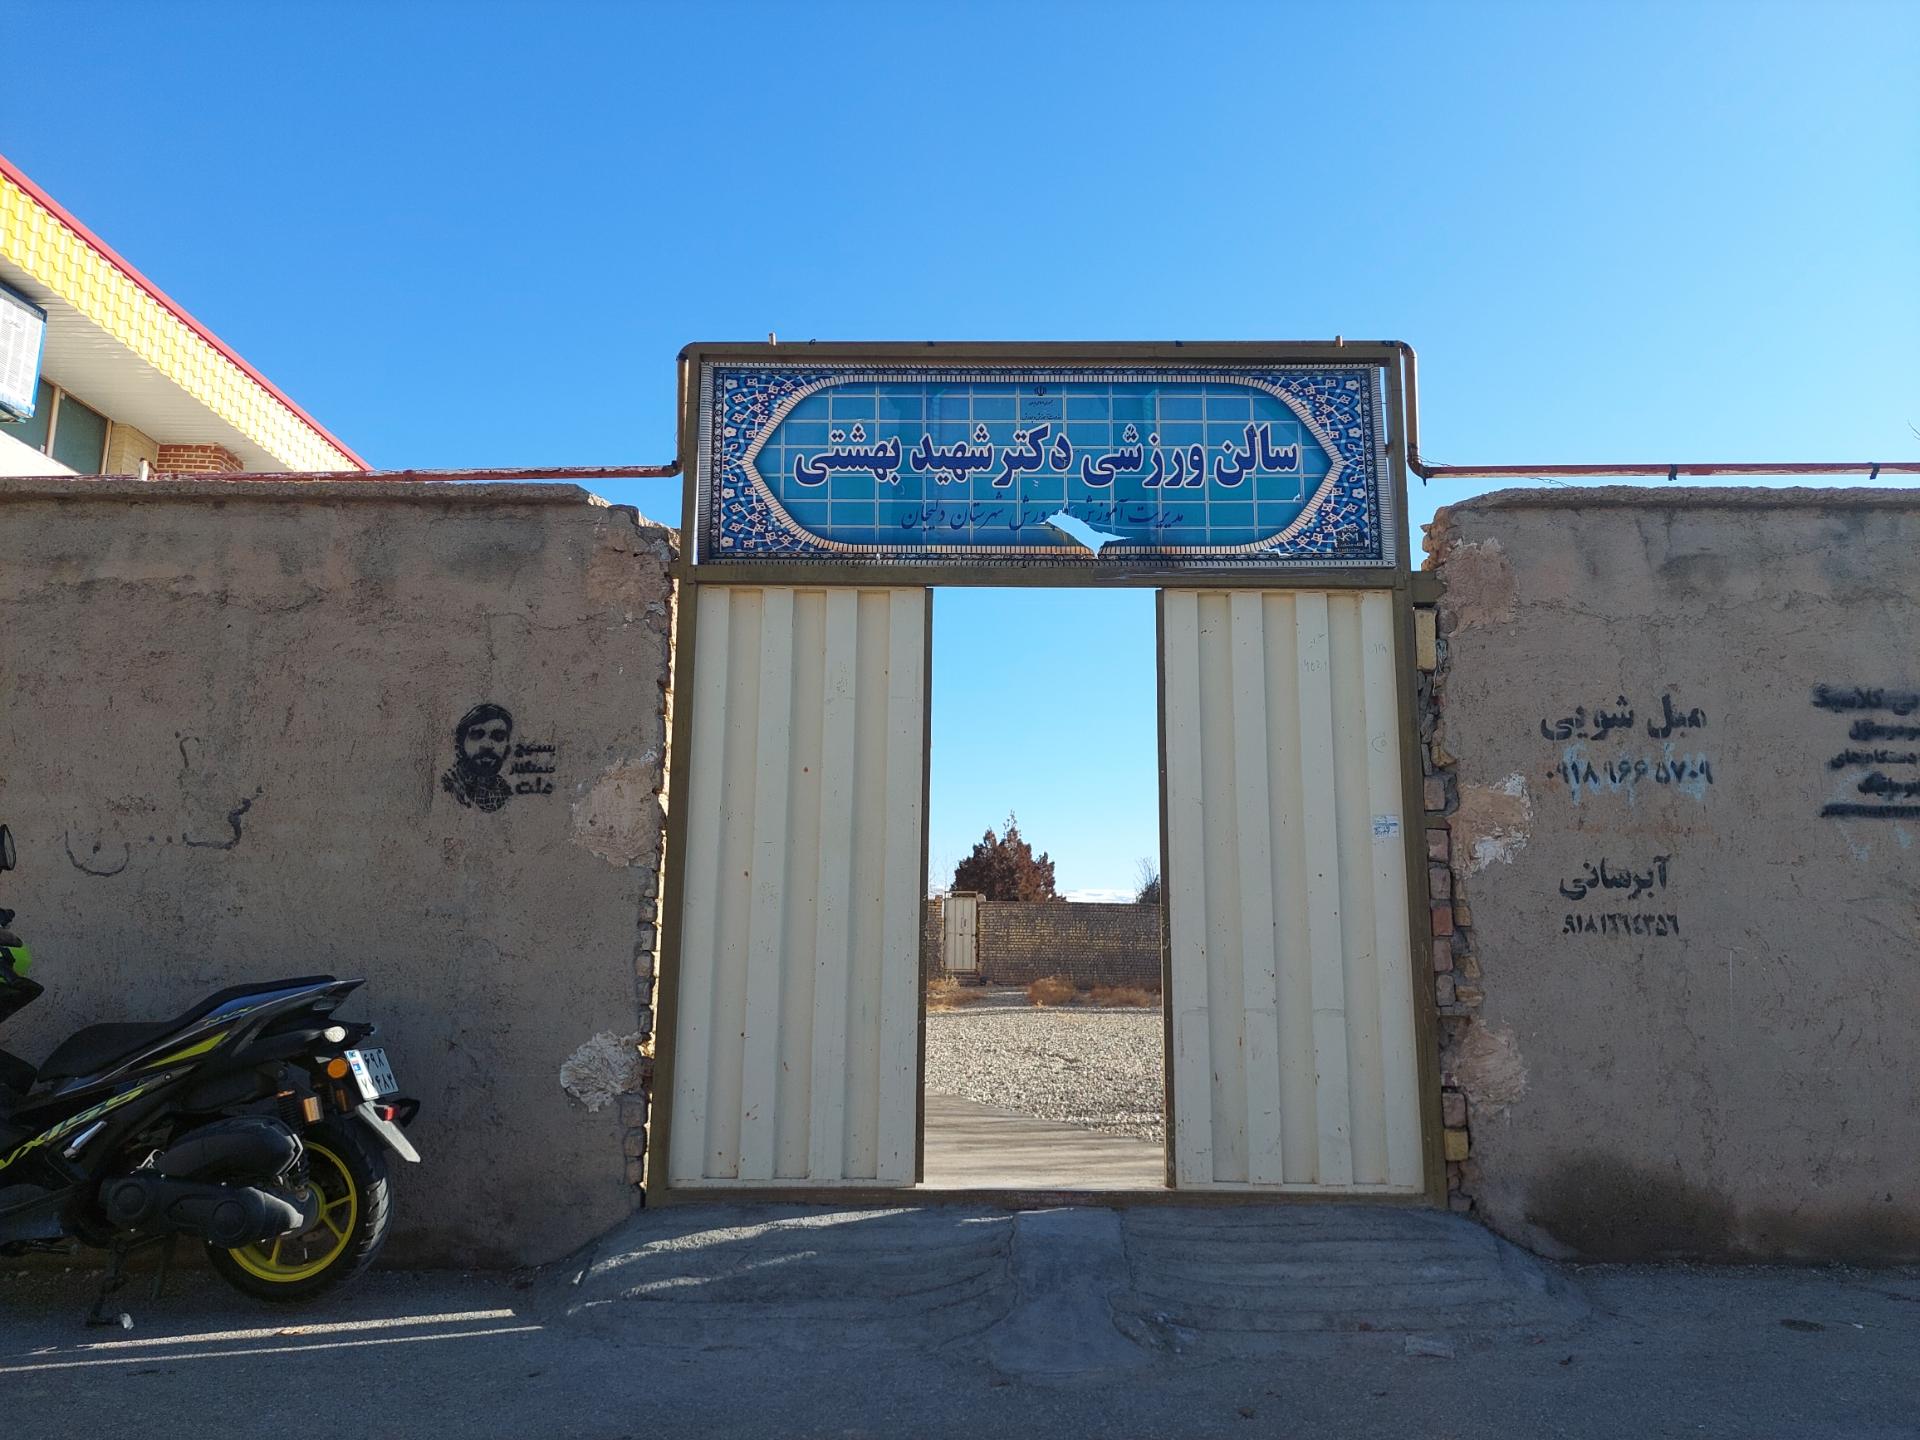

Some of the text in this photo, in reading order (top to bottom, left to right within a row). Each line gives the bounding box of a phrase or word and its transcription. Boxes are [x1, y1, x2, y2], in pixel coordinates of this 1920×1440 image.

[794, 422, 1299, 487] سالن ورزشی دکتر شهید بهشتی
[901, 500, 945, 531] دلیجان
[950, 493, 1004, 530] شهرستان
[1127, 502, 1184, 528] مدیریت
[1647, 693, 1708, 739] مبل
[1559, 853, 1672, 900] آبرسانی
